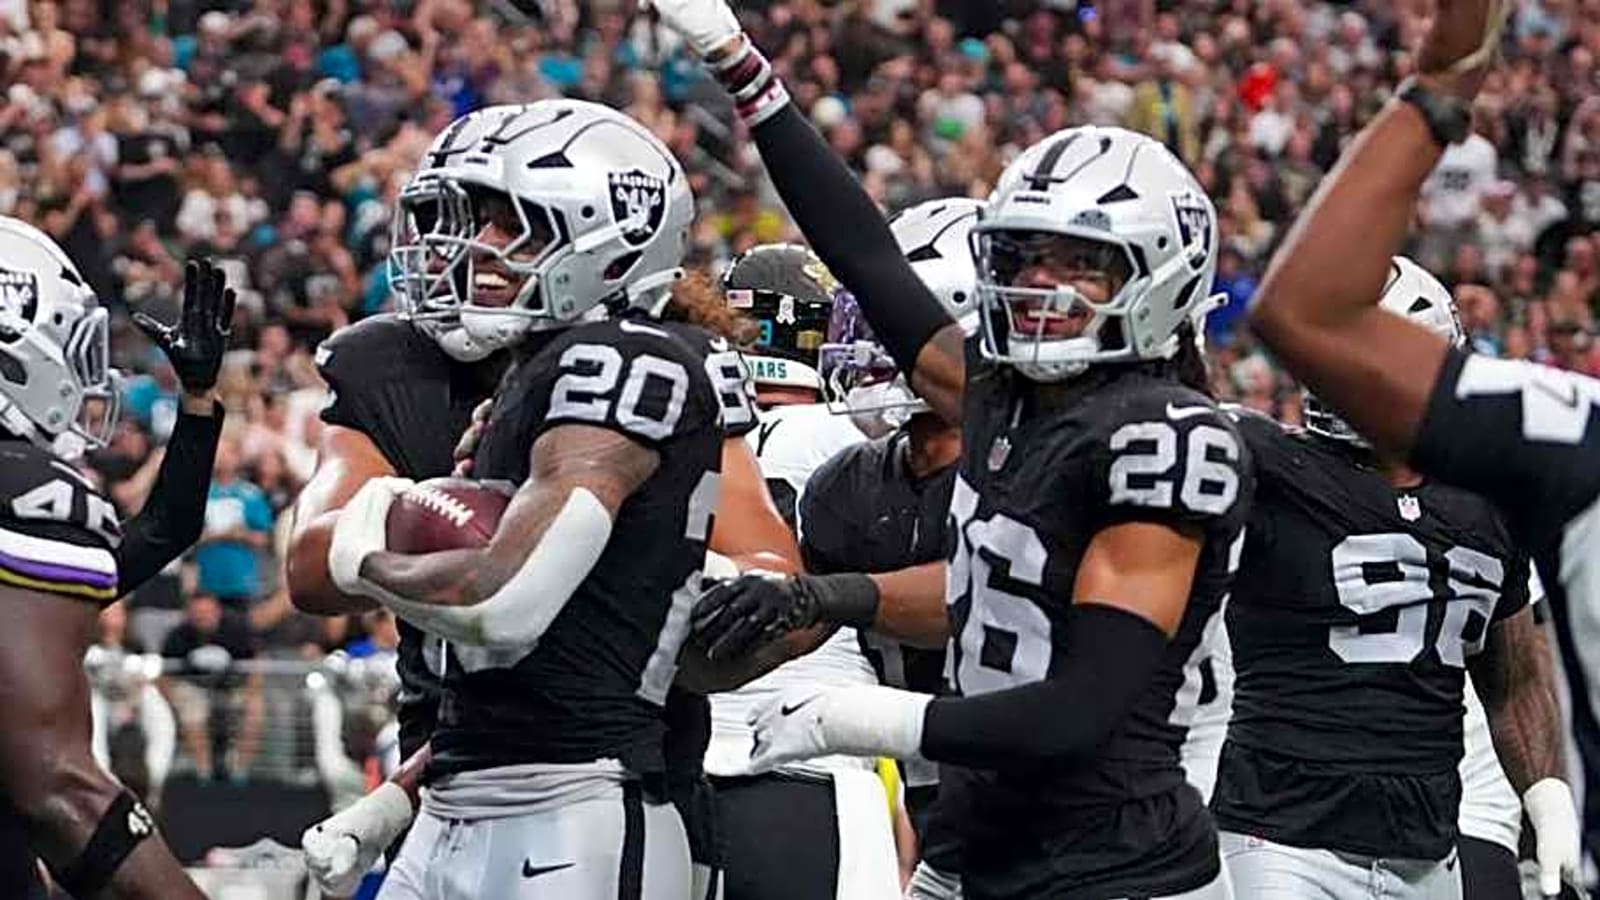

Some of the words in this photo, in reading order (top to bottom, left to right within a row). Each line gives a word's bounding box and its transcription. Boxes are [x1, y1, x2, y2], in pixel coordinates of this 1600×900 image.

[546, 344, 689, 441] 20
[704, 351, 757, 424] 8
[1109, 421, 1240, 515] 26
[1328, 532, 1504, 668] 96
